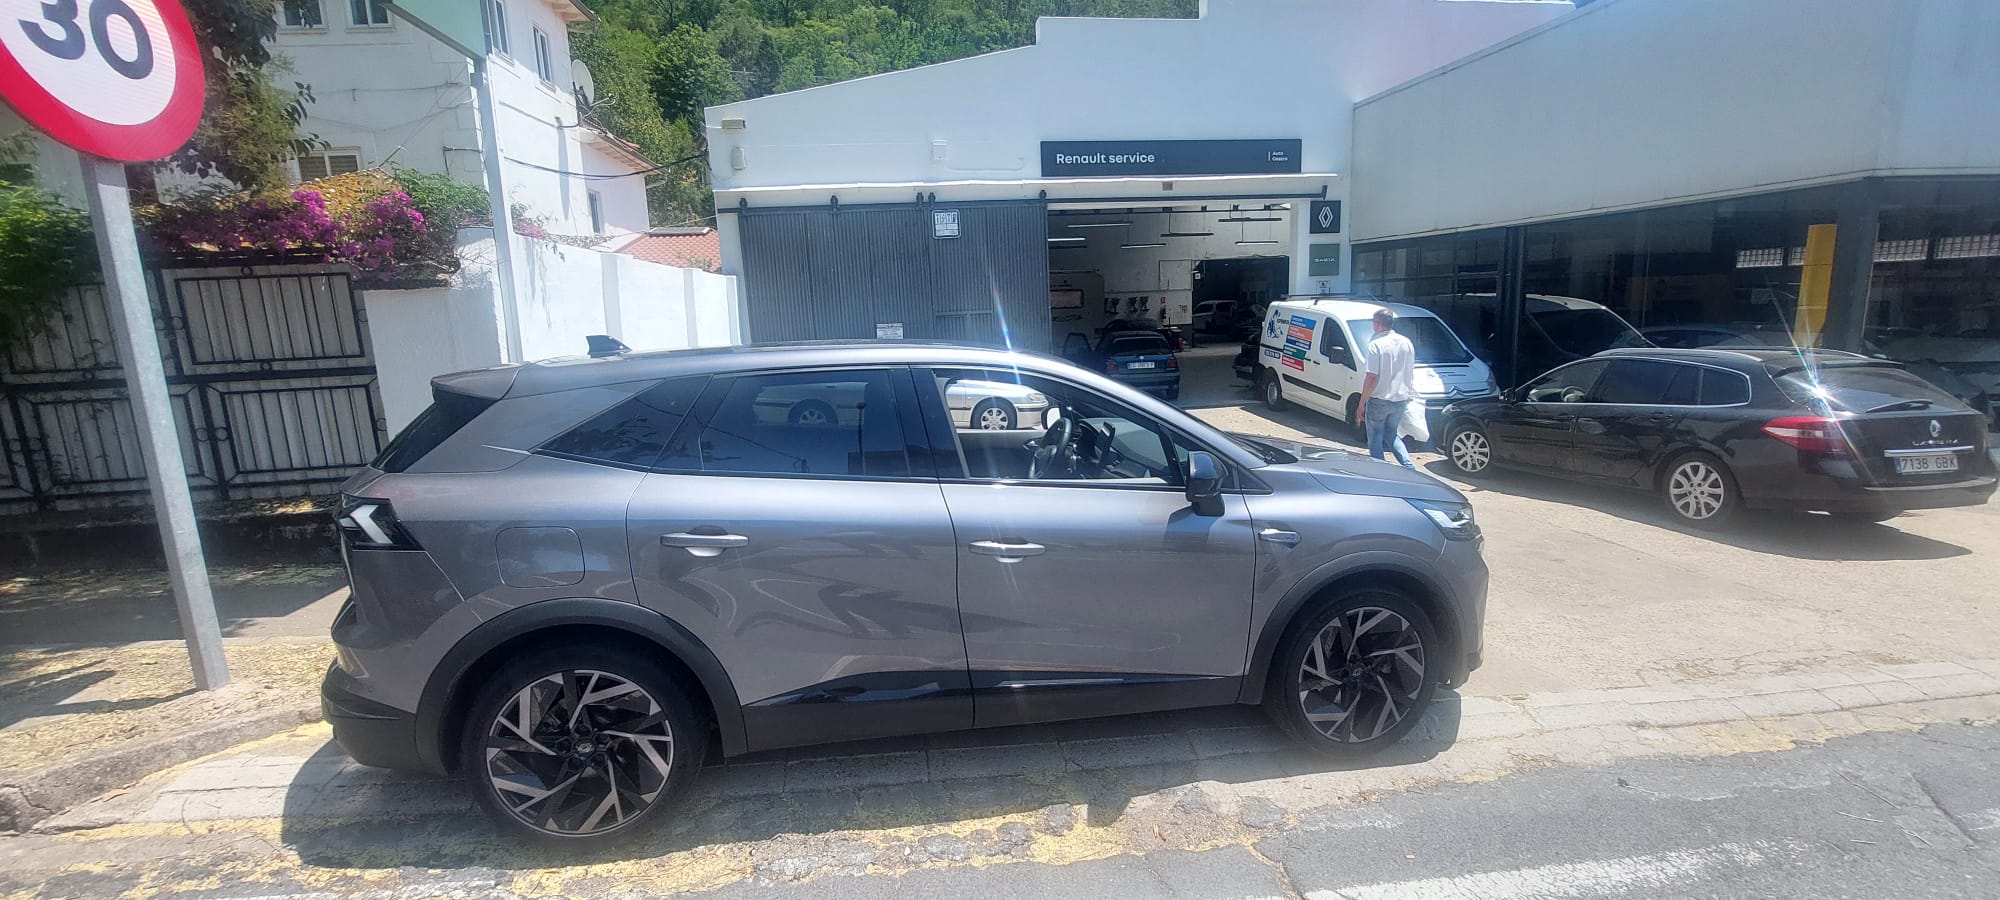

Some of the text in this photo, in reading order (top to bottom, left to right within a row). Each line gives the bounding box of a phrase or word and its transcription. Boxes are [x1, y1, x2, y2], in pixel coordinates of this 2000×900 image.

[18, 0, 154, 80] 30
[1056, 151, 1155, 164] Renault service
[1901, 455, 1957, 471] 7138 GBK
